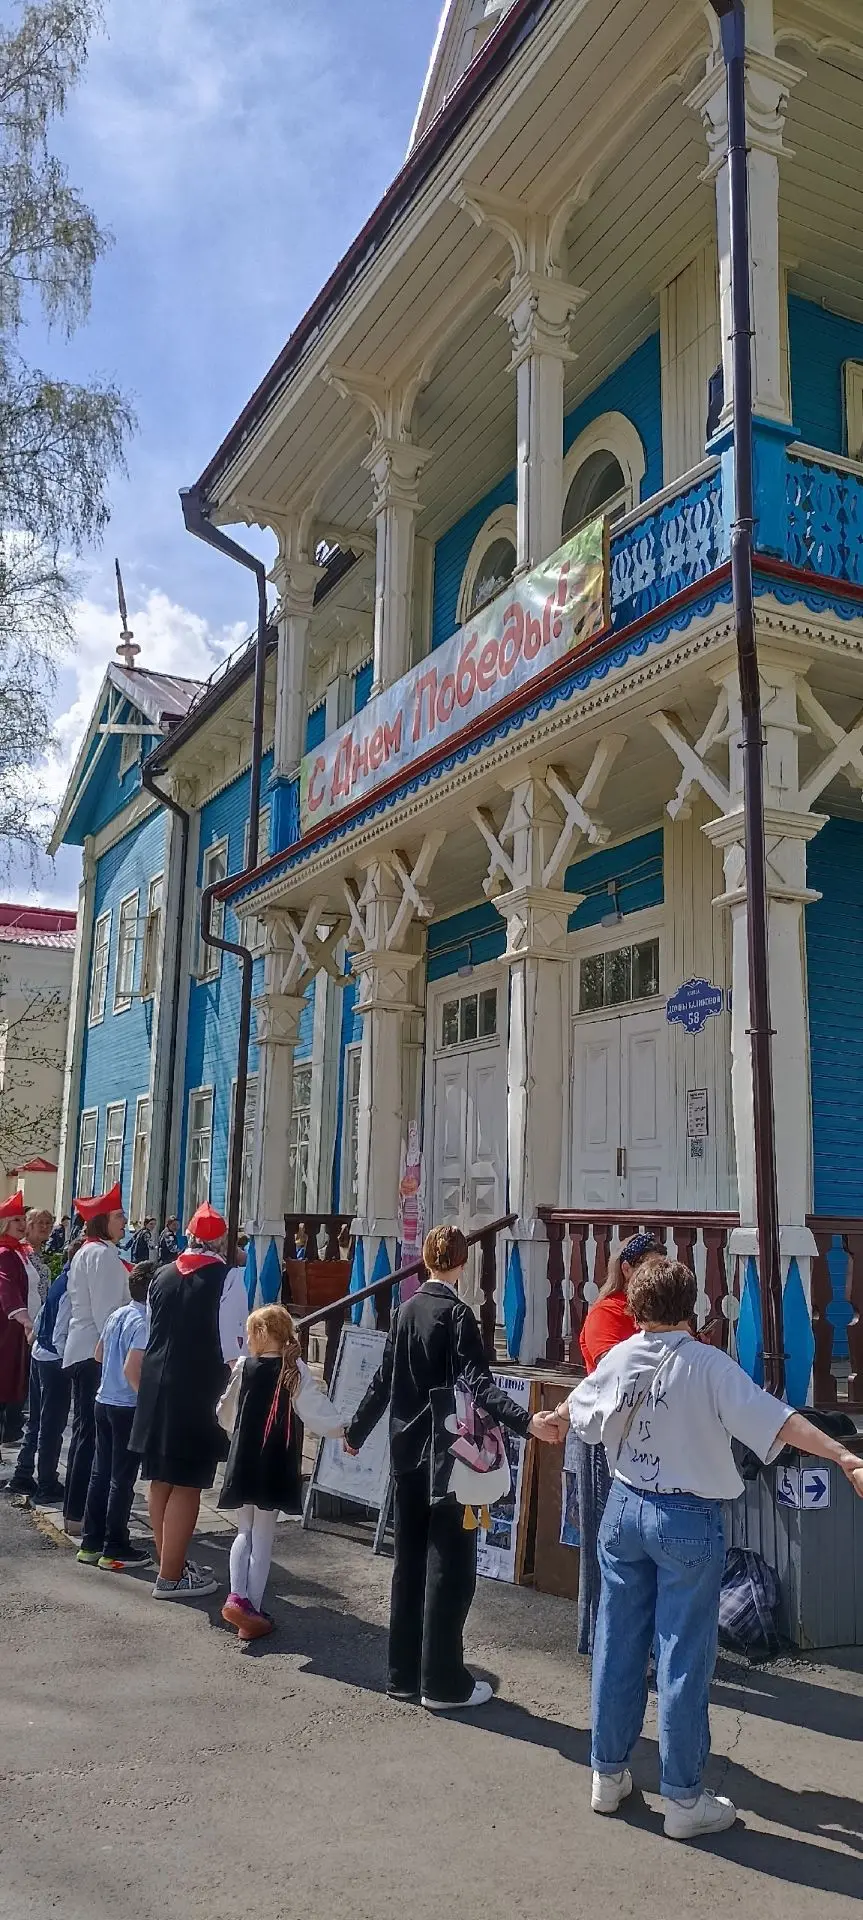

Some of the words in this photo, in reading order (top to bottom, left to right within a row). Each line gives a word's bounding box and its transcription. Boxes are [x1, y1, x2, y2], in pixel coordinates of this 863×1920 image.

[307, 755, 326, 812] С
[330, 710, 403, 806] Днем
[412, 560, 570, 743] Победы!
[688, 1011, 700, 1025] 58
